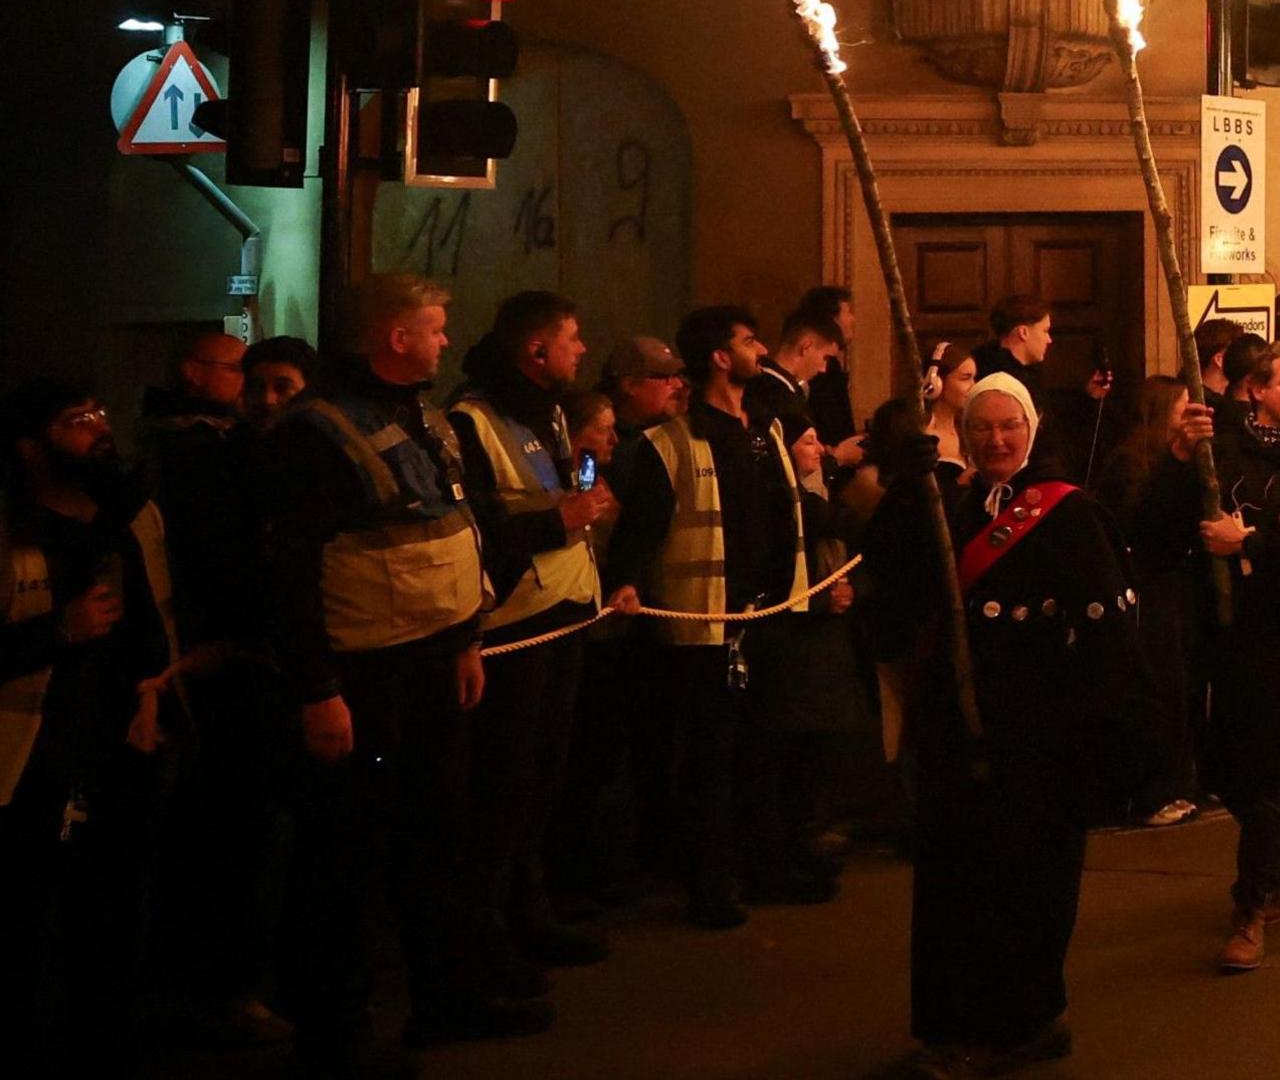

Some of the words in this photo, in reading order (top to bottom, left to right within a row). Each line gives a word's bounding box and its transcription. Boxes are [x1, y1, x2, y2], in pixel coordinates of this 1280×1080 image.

[1213, 115, 1253, 135] LBBS
[1209, 224, 1246, 241] Fiite
[1248, 227, 1256, 241] &
[1209, 247, 1257, 261] works
